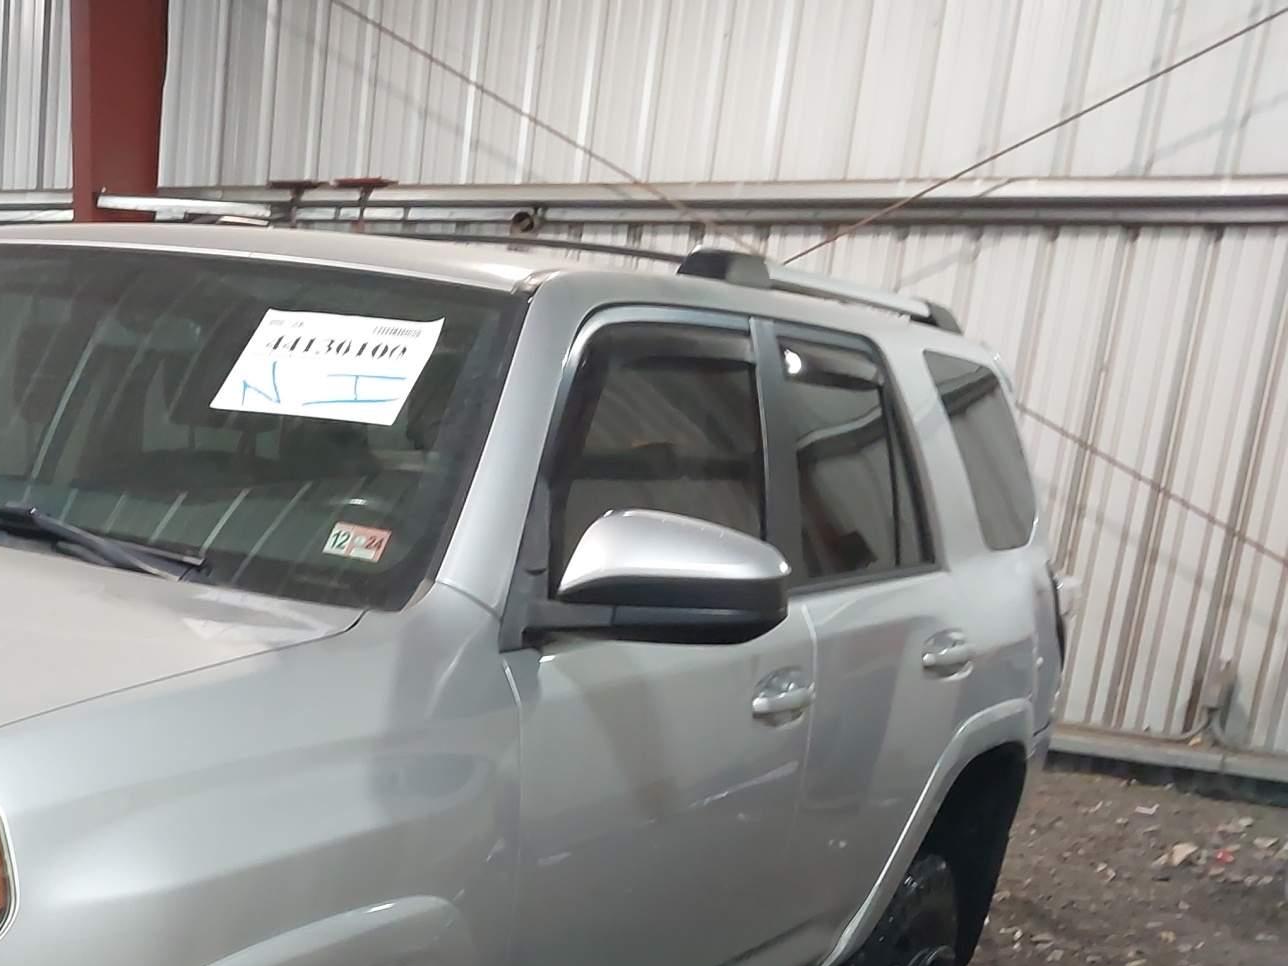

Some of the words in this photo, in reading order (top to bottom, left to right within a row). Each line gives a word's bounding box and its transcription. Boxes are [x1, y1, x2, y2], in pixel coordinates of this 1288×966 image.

[265, 335, 408, 360] 44130100
[241, 361, 281, 406] N
[330, 529, 351, 550] 12
